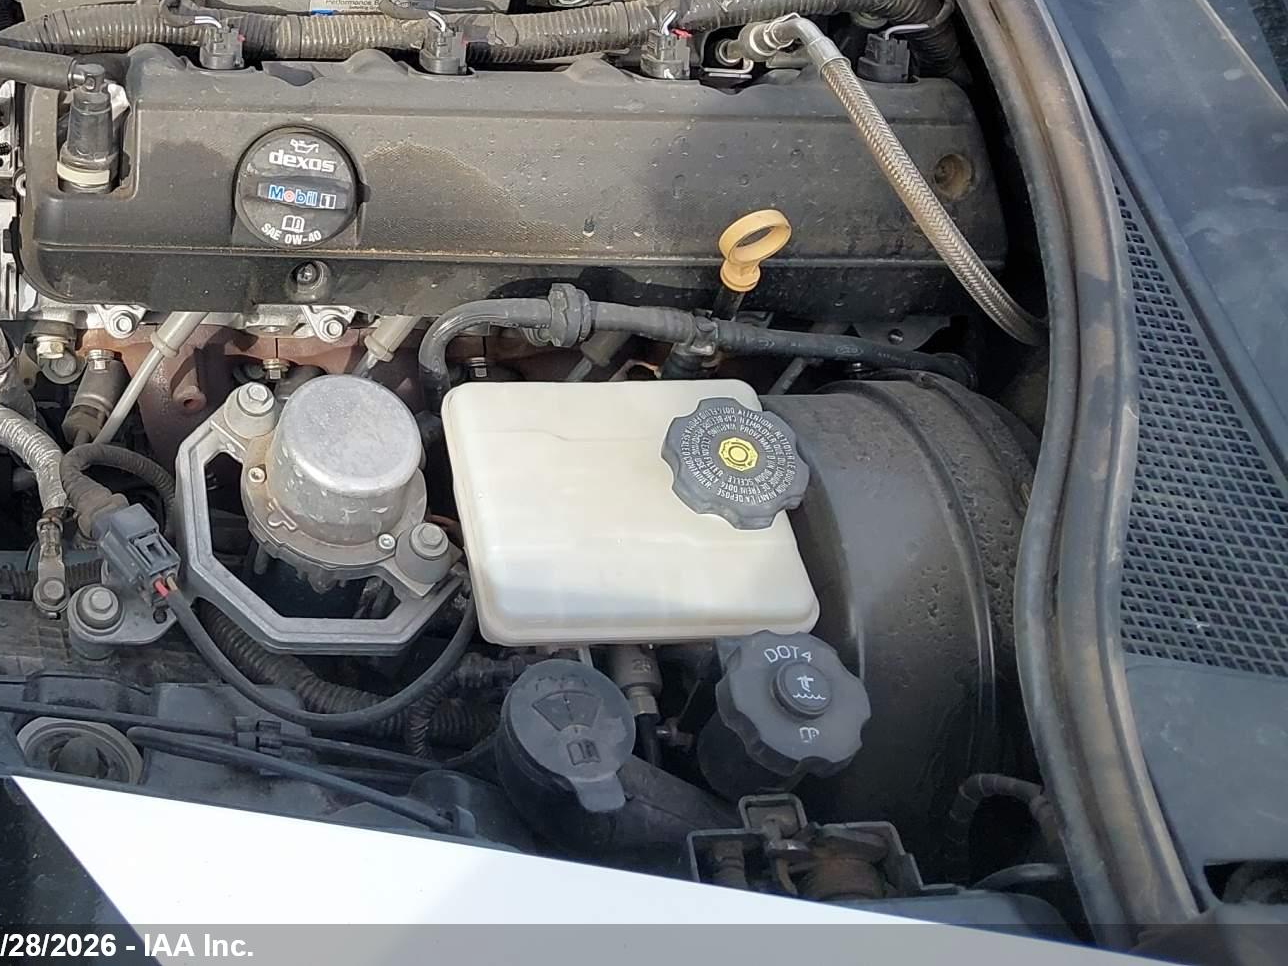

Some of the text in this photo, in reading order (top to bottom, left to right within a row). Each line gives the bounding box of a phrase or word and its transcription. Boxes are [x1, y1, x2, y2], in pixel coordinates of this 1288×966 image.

[269, 149, 336, 172] dexos
[268, 185, 318, 206] Mobil
[261, 223, 322, 245] SAE 0W-40
[715, 487, 744, 501] DEPOSE
